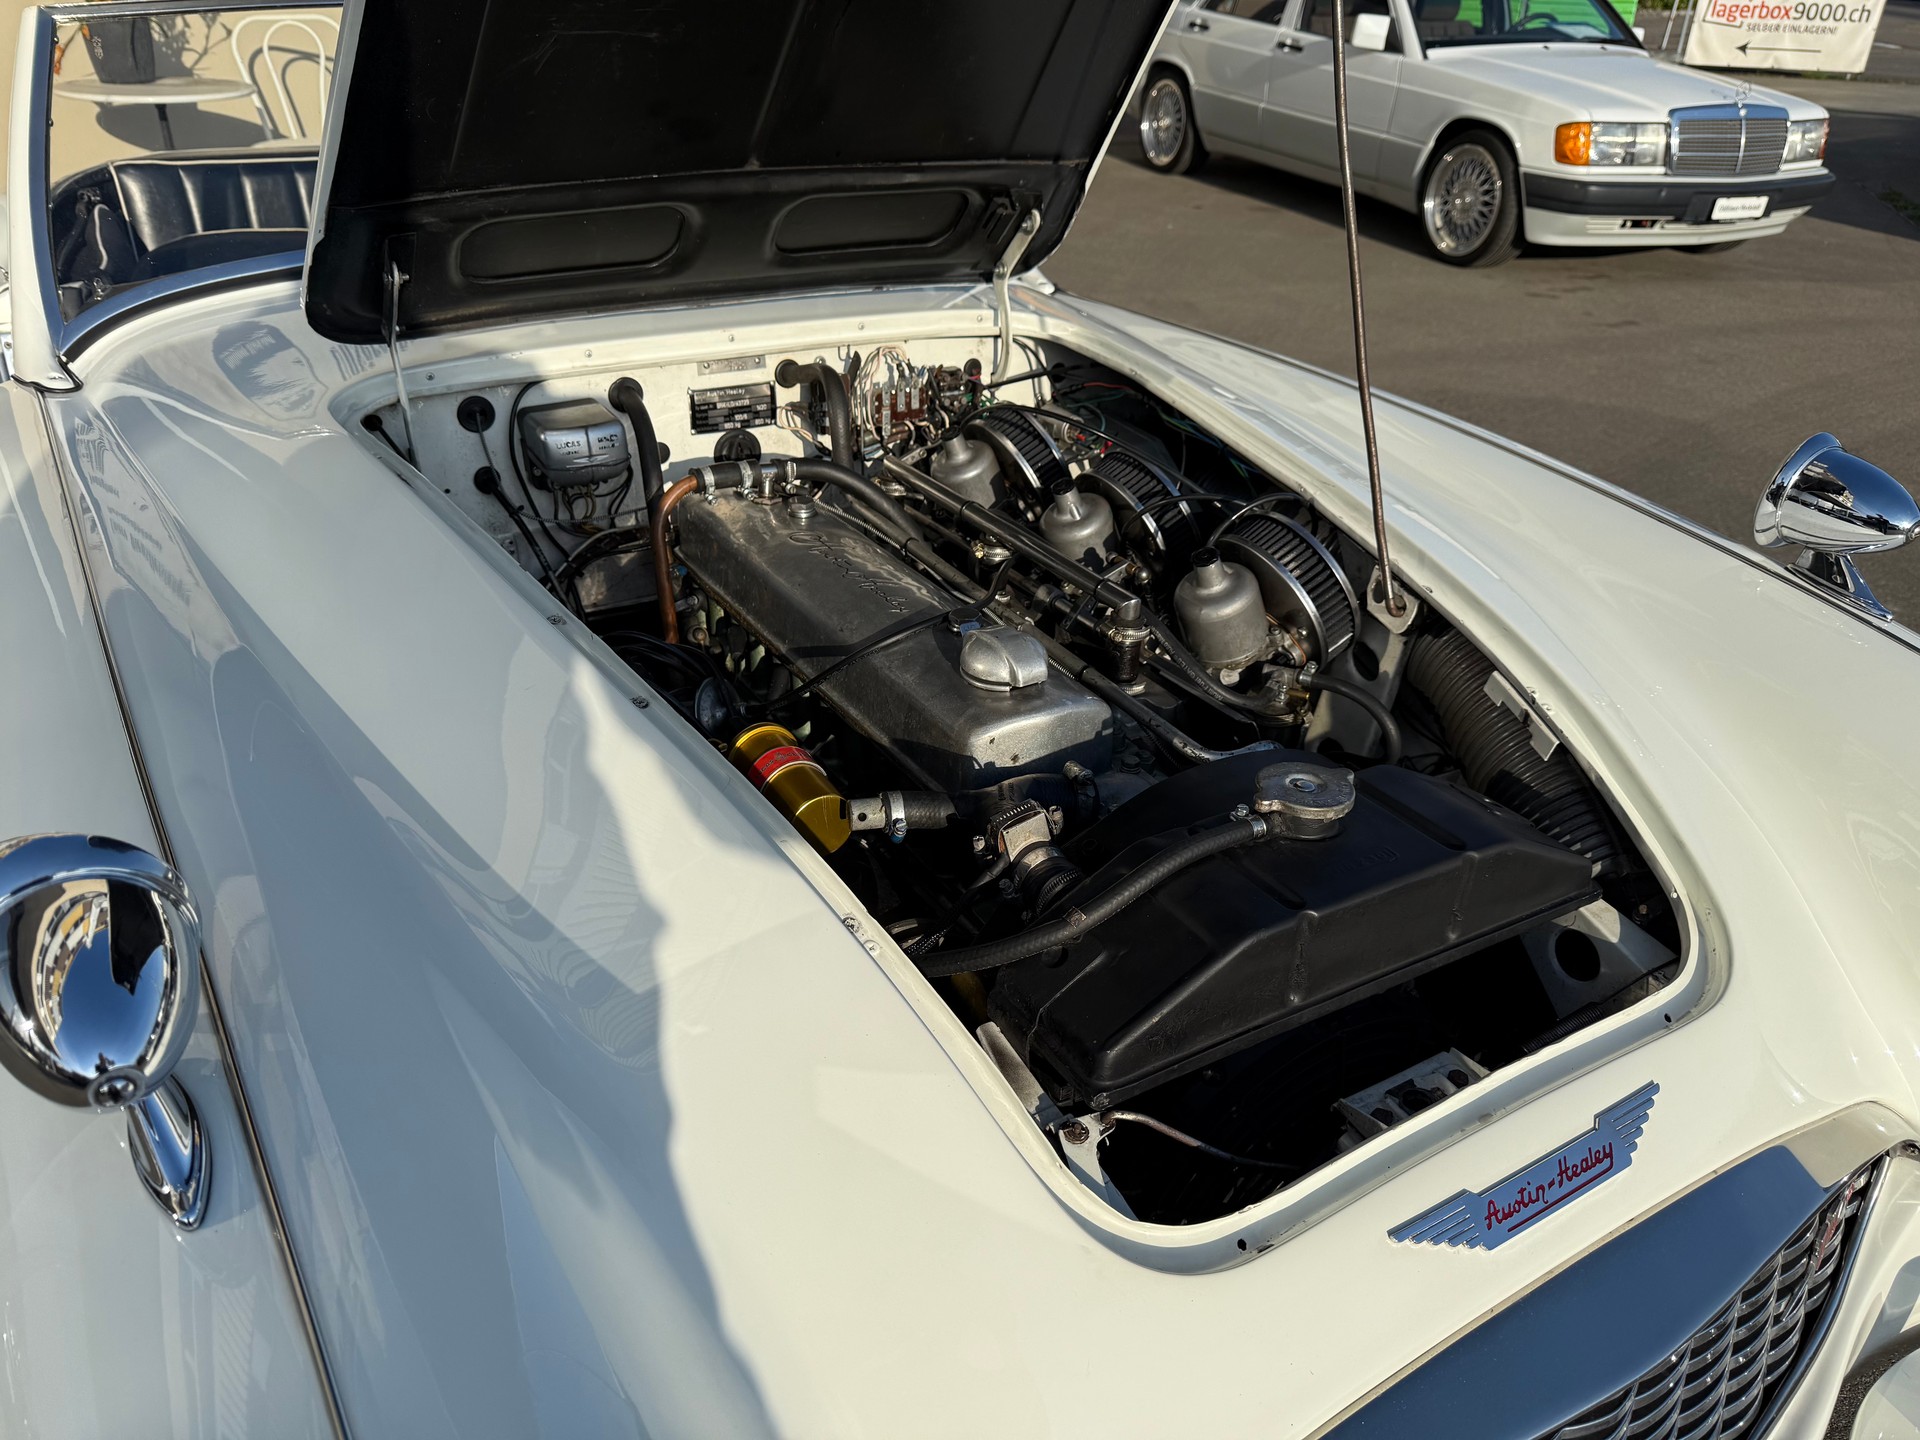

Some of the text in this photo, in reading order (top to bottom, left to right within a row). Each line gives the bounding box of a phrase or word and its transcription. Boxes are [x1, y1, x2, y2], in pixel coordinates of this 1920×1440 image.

[1711, 0, 1871, 23] lagerbox9000.ch
[1746, 22, 1781, 33] SELBER
[555, 440, 582, 450] LUCAS
[1484, 1141, 1614, 1231] Austin-Healey
